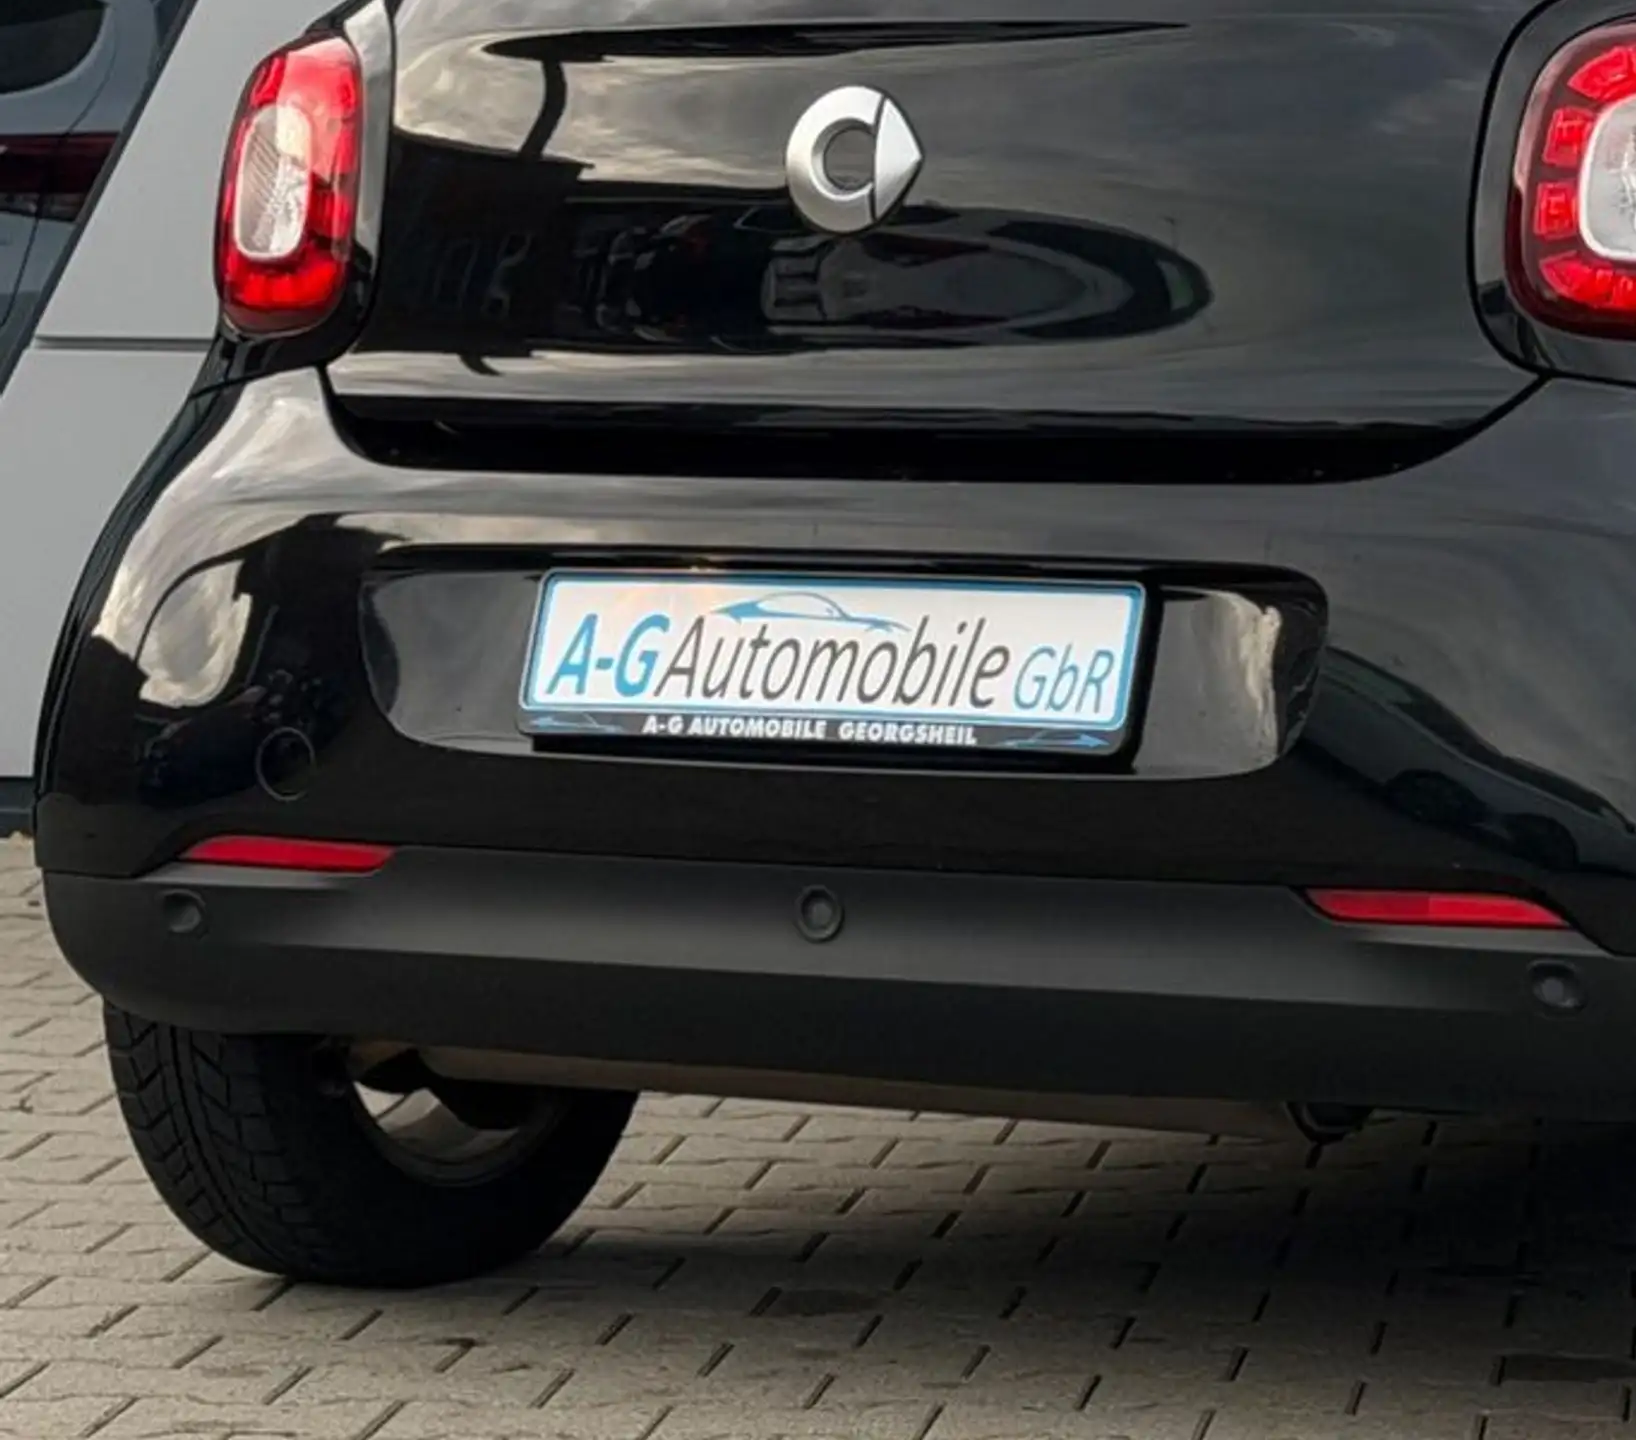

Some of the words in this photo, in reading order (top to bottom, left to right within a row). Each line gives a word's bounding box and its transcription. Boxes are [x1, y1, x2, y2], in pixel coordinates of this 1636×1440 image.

[545, 613, 671, 698] A-G
[654, 615, 1010, 709] Automobile
[1013, 644, 1116, 714] GbR
[642, 715, 685, 734] A-G
[687, 716, 827, 739] AUTOMOBILE
[838, 721, 977, 746] GEORGSHEIL
